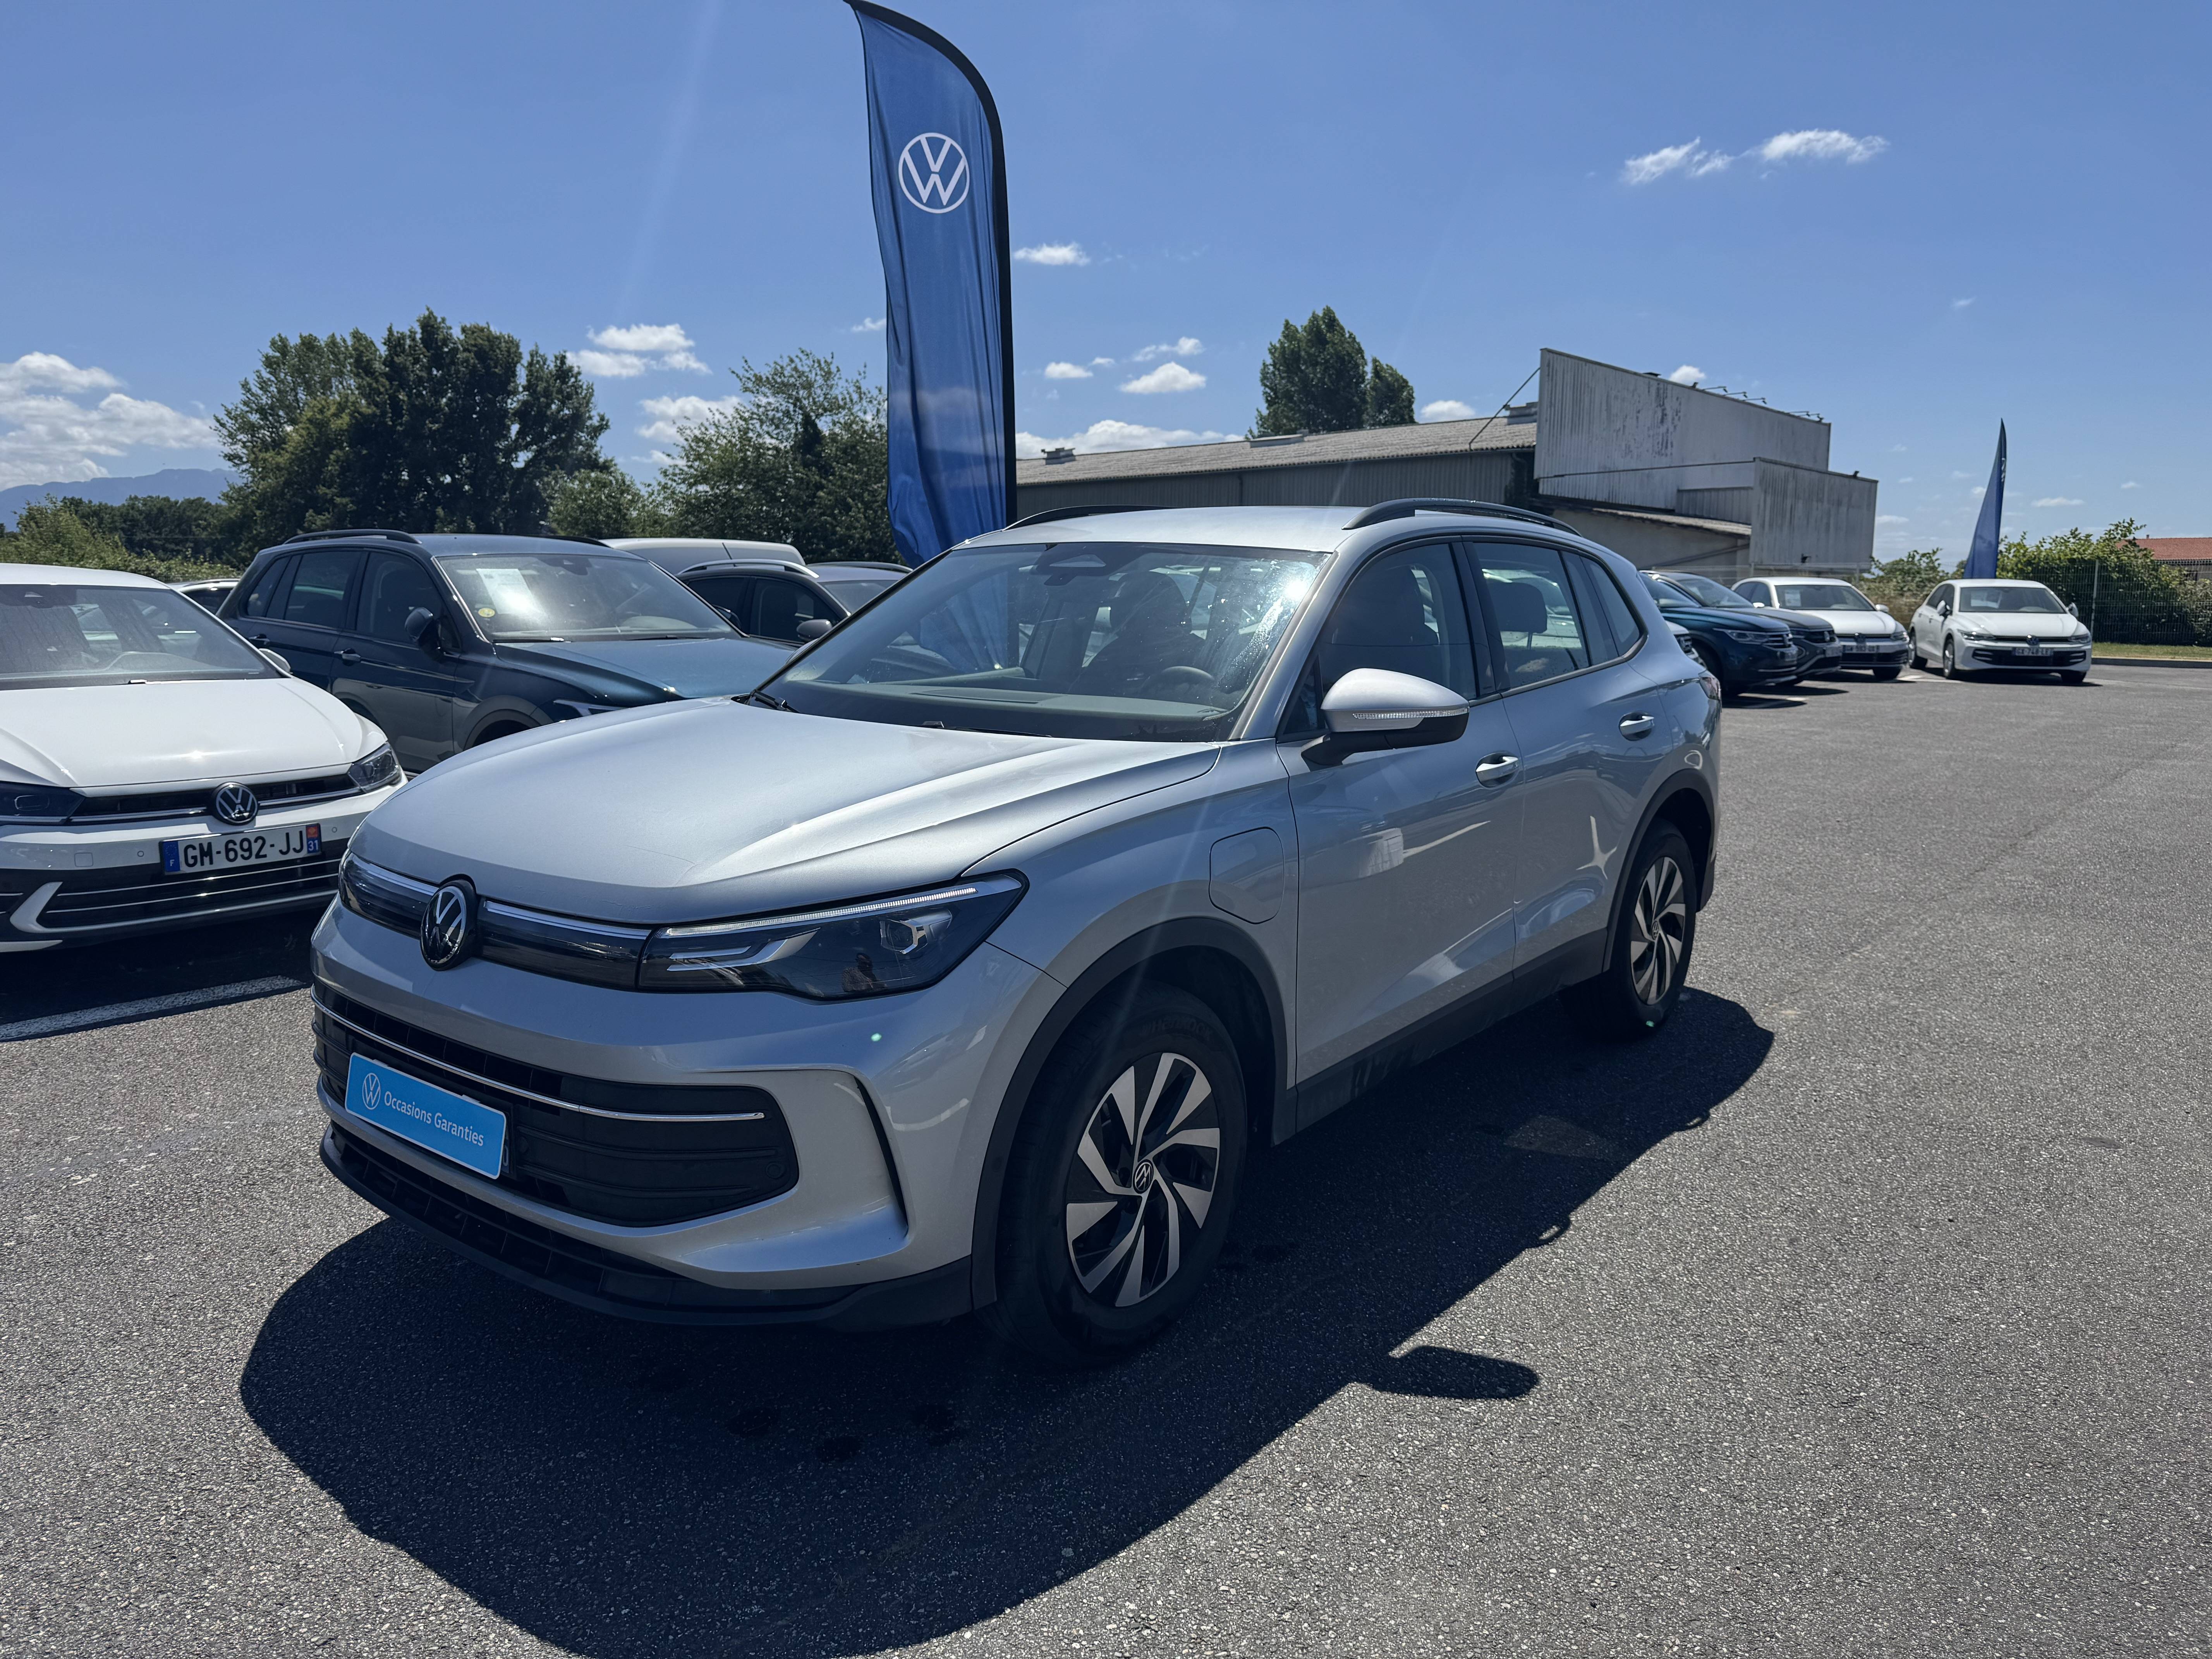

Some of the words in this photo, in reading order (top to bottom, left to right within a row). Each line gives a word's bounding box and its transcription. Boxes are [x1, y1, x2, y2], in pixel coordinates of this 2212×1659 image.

[184, 830, 303, 867] GM-692-JJ
[308, 840, 319, 851] 31
[384, 1091, 432, 1123] Occasions
[434, 1113, 484, 1146] Garanties
